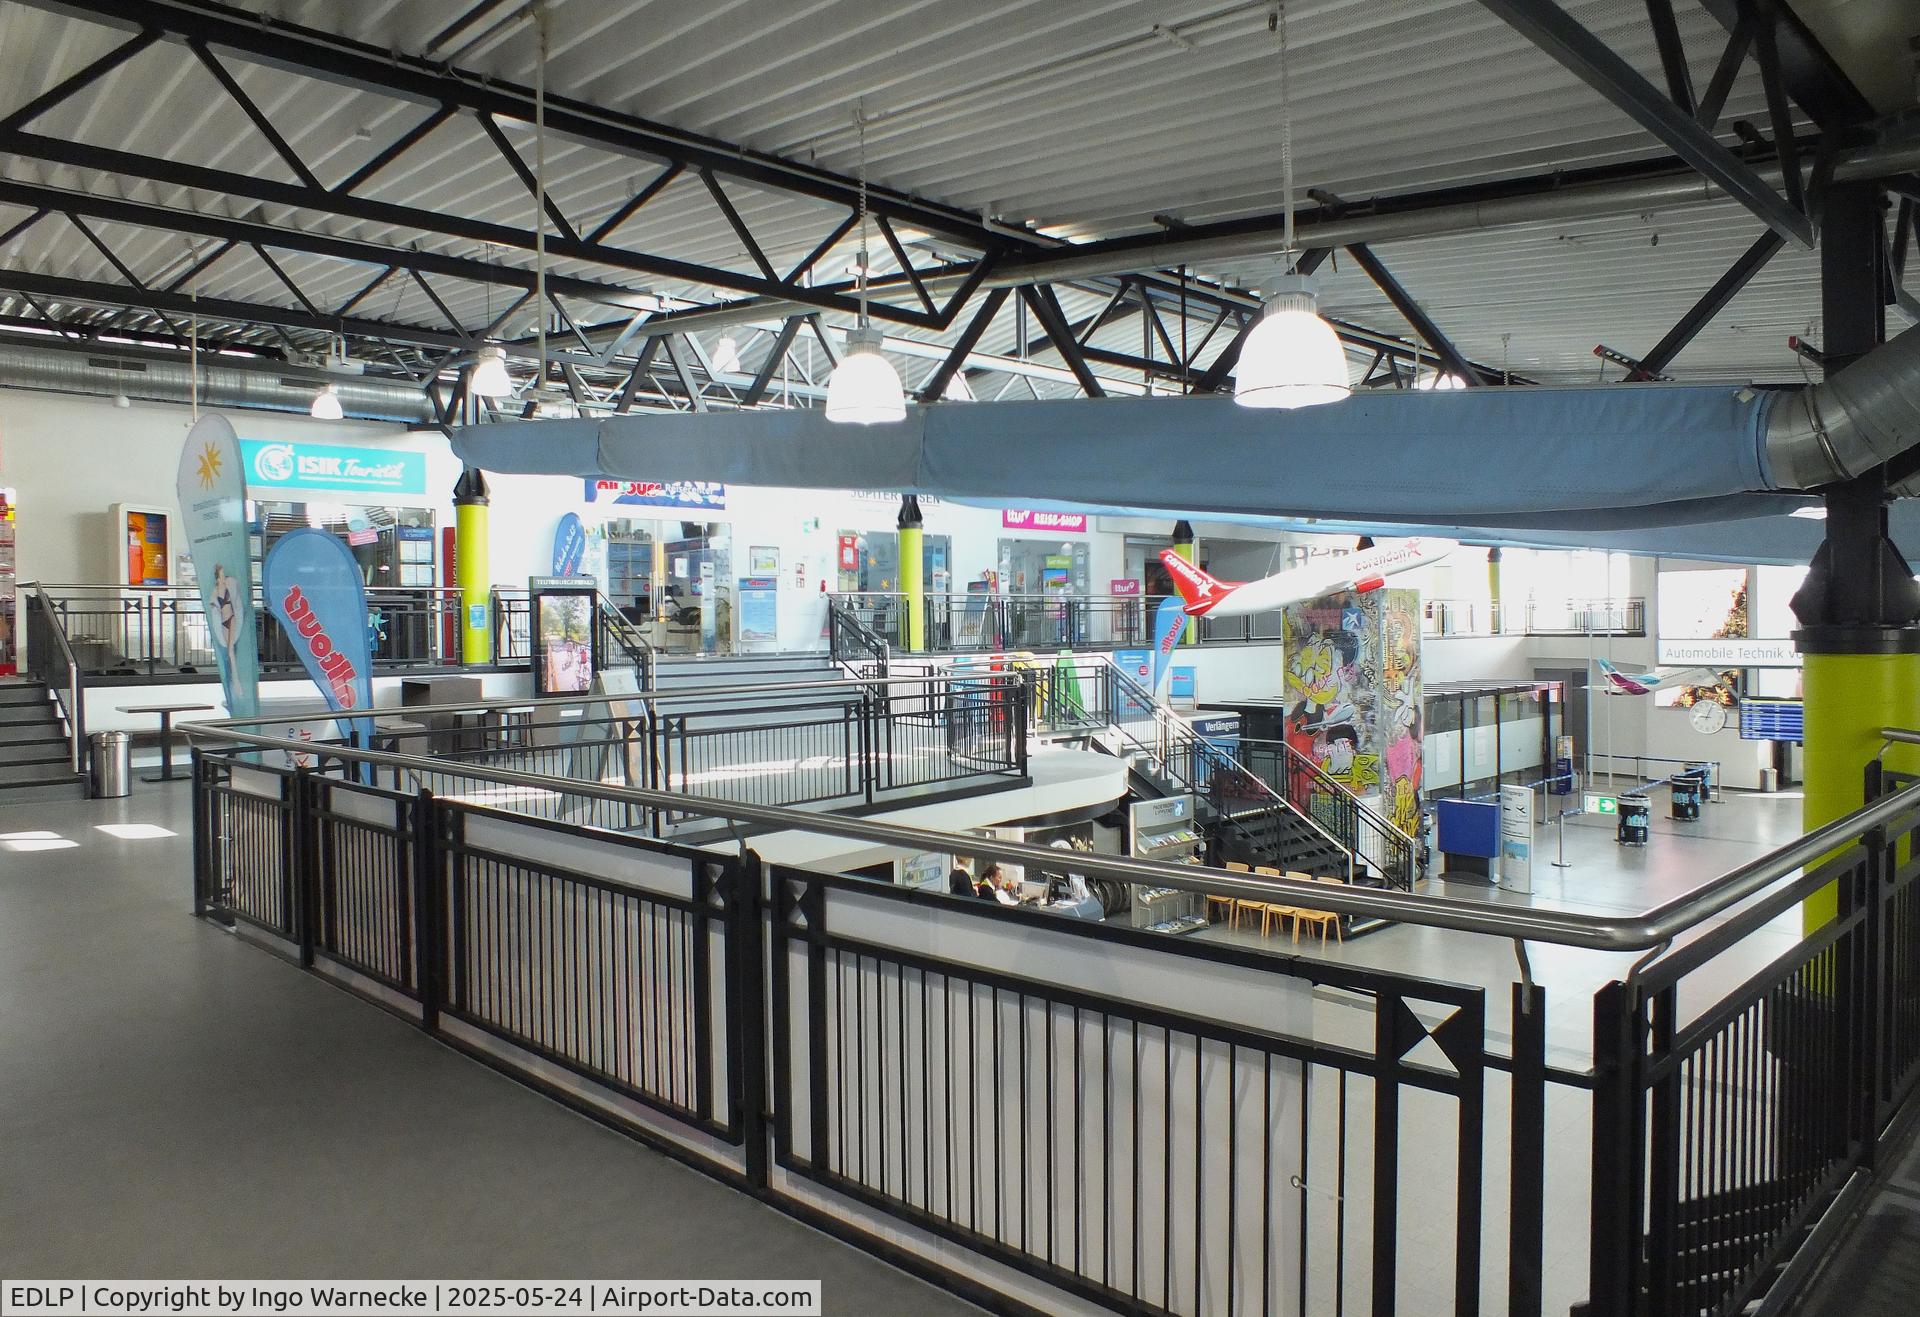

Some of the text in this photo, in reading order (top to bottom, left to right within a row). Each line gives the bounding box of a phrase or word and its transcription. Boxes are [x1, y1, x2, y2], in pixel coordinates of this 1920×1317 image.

[297, 456, 342, 476] ISIK
[597, 480, 662, 497] allours
[851, 489, 898, 501] JUPITER
[1162, 614, 1185, 655] alltours
[1666, 648, 1734, 659] Automobile
[1738, 647, 1784, 659] Technik
[1205, 720, 1239, 732] Verlängern
